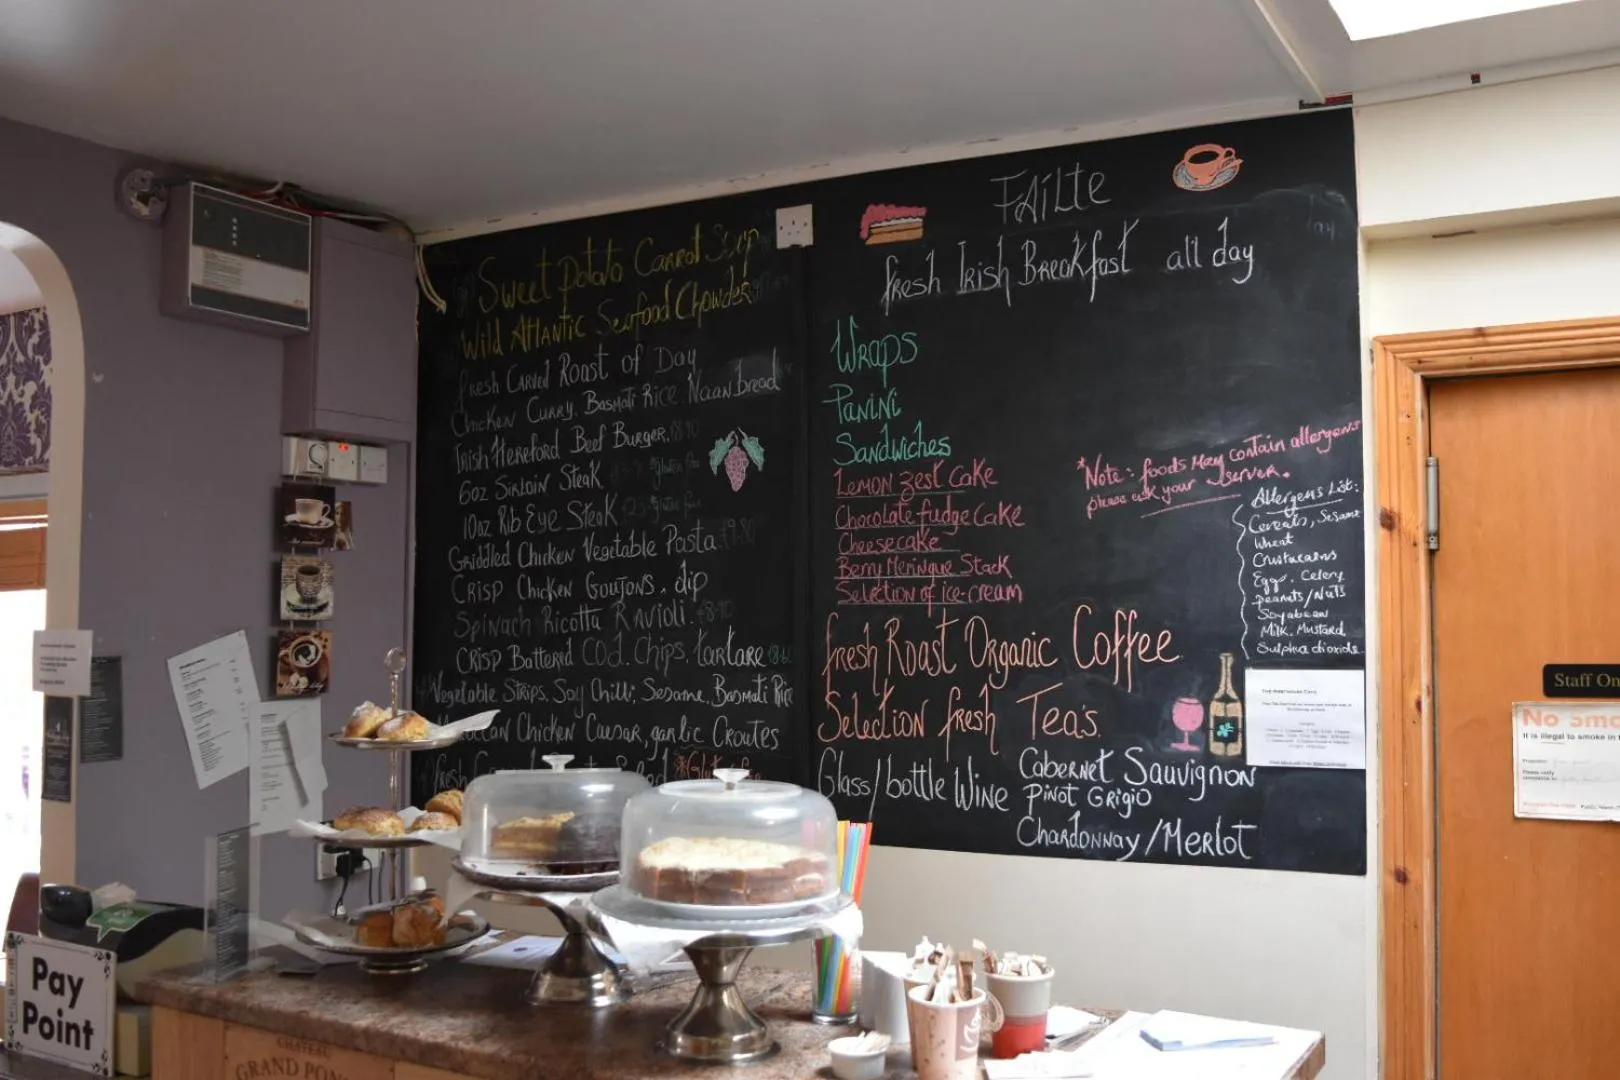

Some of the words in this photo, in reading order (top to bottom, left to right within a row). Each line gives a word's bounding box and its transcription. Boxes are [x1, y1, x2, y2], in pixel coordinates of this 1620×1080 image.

[479, 244, 553, 314] Sweet
[557, 236, 624, 314] Potato
[634, 223, 704, 277] Carrot
[956, 235, 1011, 308] Irish
[1018, 217, 1140, 303] Breakfast
[1167, 235, 1201, 271] all
[1212, 216, 1255, 284] day
[461, 316, 504, 361] Wild
[597, 278, 671, 346] Seafood
[559, 342, 609, 388] Roast
[621, 343, 645, 376] of
[654, 345, 697, 376] Day
[829, 314, 918, 389] Wraps
[688, 370, 732, 405] Naan
[732, 345, 782, 398] bread
[822, 383, 902, 424] Panini
[455, 442, 489, 475] Irish
[491, 428, 560, 468] Hereford
[570, 424, 607, 454] Beef
[833, 416, 952, 467] Sandwiches
[1140, 457, 1187, 485] foods
[1229, 433, 1286, 462] contain
[458, 480, 489, 506] 6oz
[559, 460, 605, 491] Steak
[834, 467, 893, 497] Lemon
[1162, 479, 1197, 505] your
[1251, 486, 1323, 518] Allergens
[497, 504, 522, 537] Rib
[526, 503, 562, 534] Eye
[566, 493, 619, 531] Steak
[835, 500, 916, 530] Chocolate
[448, 540, 513, 573] Griddled
[517, 540, 577, 570] Chicken
[583, 528, 659, 563] Vegetable
[663, 518, 717, 557] Pasta
[837, 530, 943, 555] Cheesecake
[517, 573, 575, 602] Chicken
[675, 559, 710, 604] dip
[960, 552, 1014, 580] Stack
[836, 580, 917, 605] Selection
[454, 606, 532, 644] Spinach
[541, 604, 606, 636] Ricotta
[507, 636, 575, 672] Battered
[884, 607, 959, 679] Roast
[964, 615, 1058, 690] Organic
[1073, 604, 1182, 694] Coffee
[431, 670, 497, 709] Vegetable
[553, 677, 586, 719] Soy
[1554, 671, 1593, 688] Staff
[517, 711, 577, 744] Chicken
[713, 714, 781, 752] Croutes
[817, 678, 930, 743] Selection
[1521, 707, 1560, 728] No
[1541, 732, 1565, 742] illegal
[1578, 732, 1605, 741] smoke
[954, 756, 1010, 813] Wine
[1019, 745, 1114, 785] Cabernet
[1122, 745, 1258, 802] Sauvignon
[1087, 785, 1153, 820] Grigio
[32, 956, 84, 1009] Pay
[22, 1000, 94, 1052] Point
